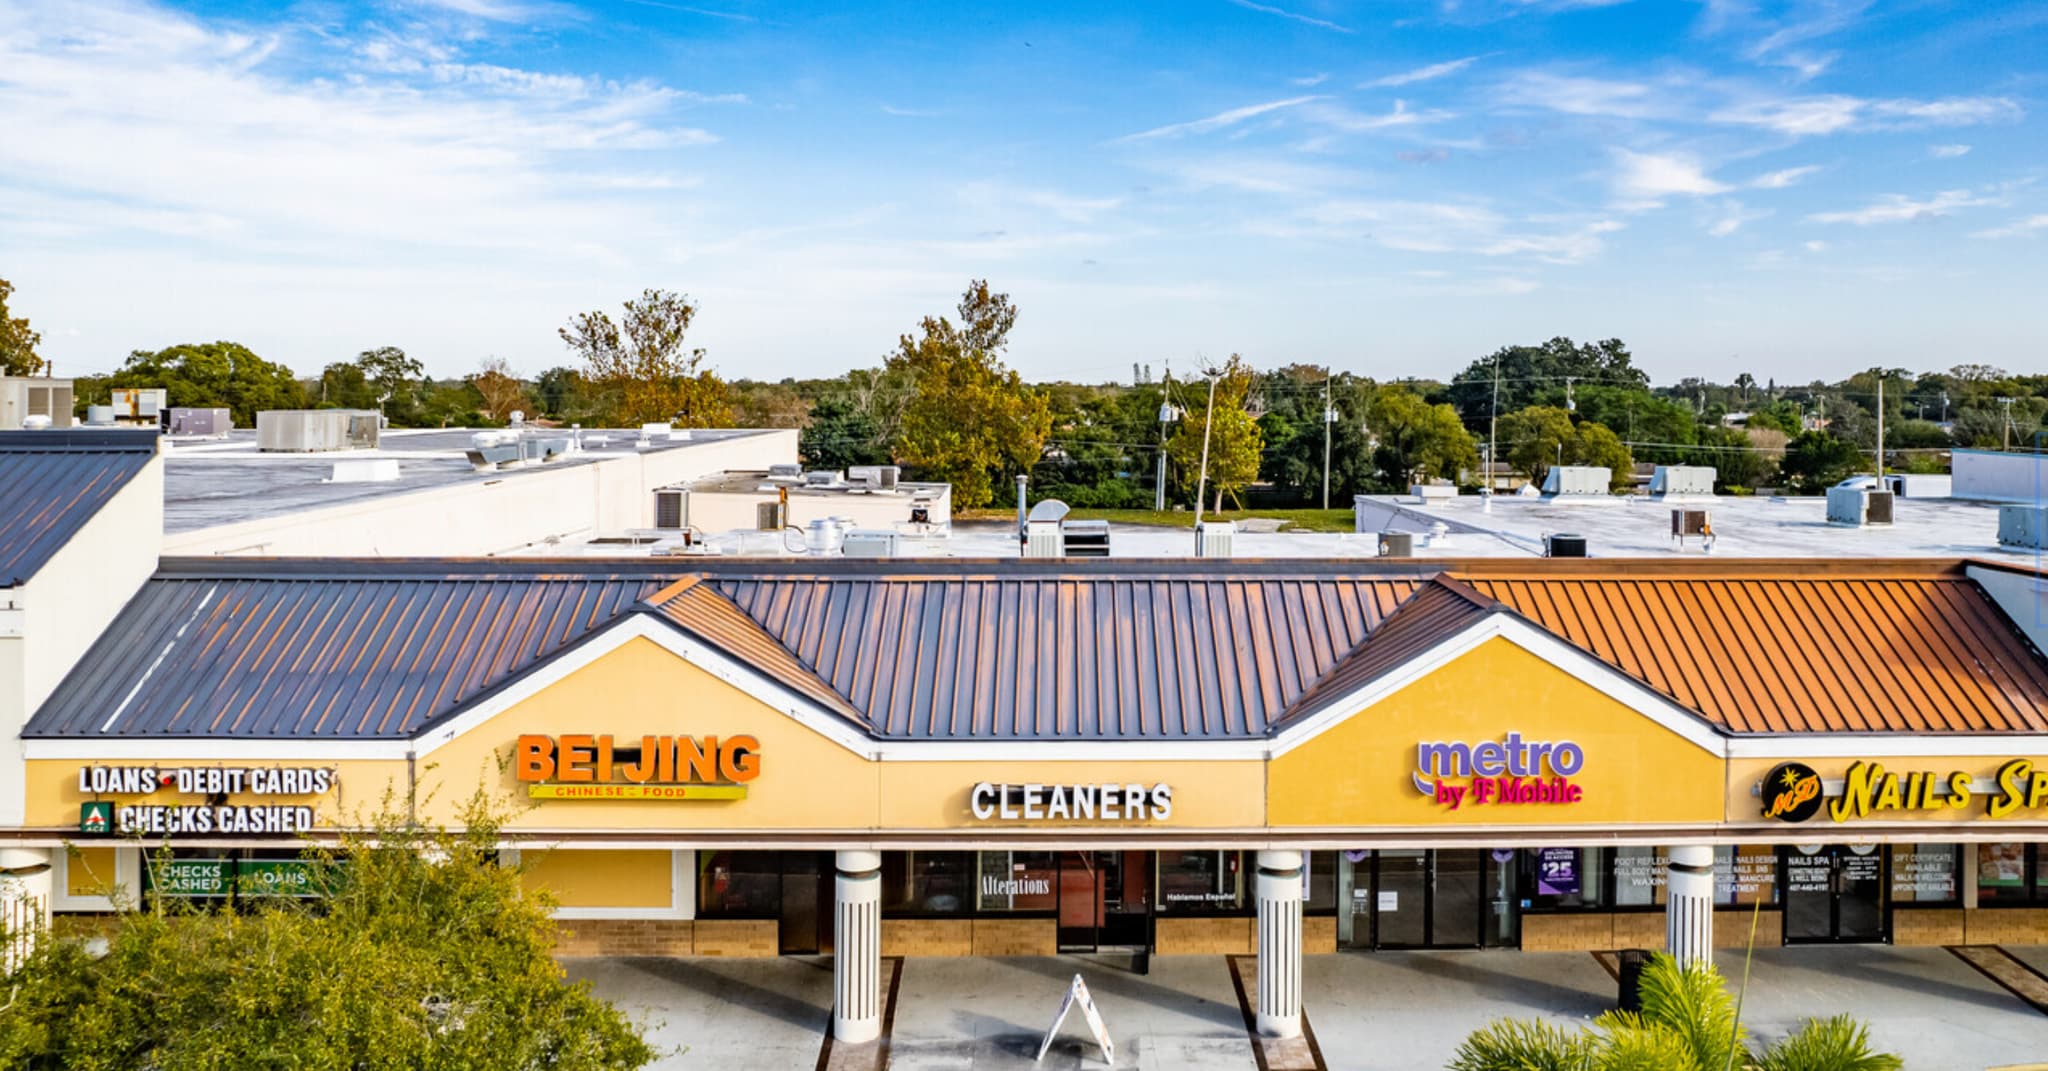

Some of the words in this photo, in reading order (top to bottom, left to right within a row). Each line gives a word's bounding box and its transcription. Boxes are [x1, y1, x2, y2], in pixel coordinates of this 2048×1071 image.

[1417, 732, 1584, 777] metro
[80, 767, 156, 793] LOANS
[178, 767, 244, 794] DEBIT
[251, 769, 329, 794] CARDS
[555, 787, 625, 797] CHINESE
[643, 787, 686, 798] FOOD
[1830, 760, 1973, 823] NAILS
[971, 781, 1172, 821] CLEANERS
[1436, 779, 1466, 810] by
[120, 806, 212, 833] CHECKS
[219, 806, 312, 833] CASHED
[160, 865, 221, 878] CHECKS
[1788, 856, 1812, 866] NAILS
[1813, 856, 1829, 865] SPA
[160, 878, 222, 890] CASHED
[982, 874, 1050, 895] Alterations
[1166, 893, 1204, 901] Hablamos
